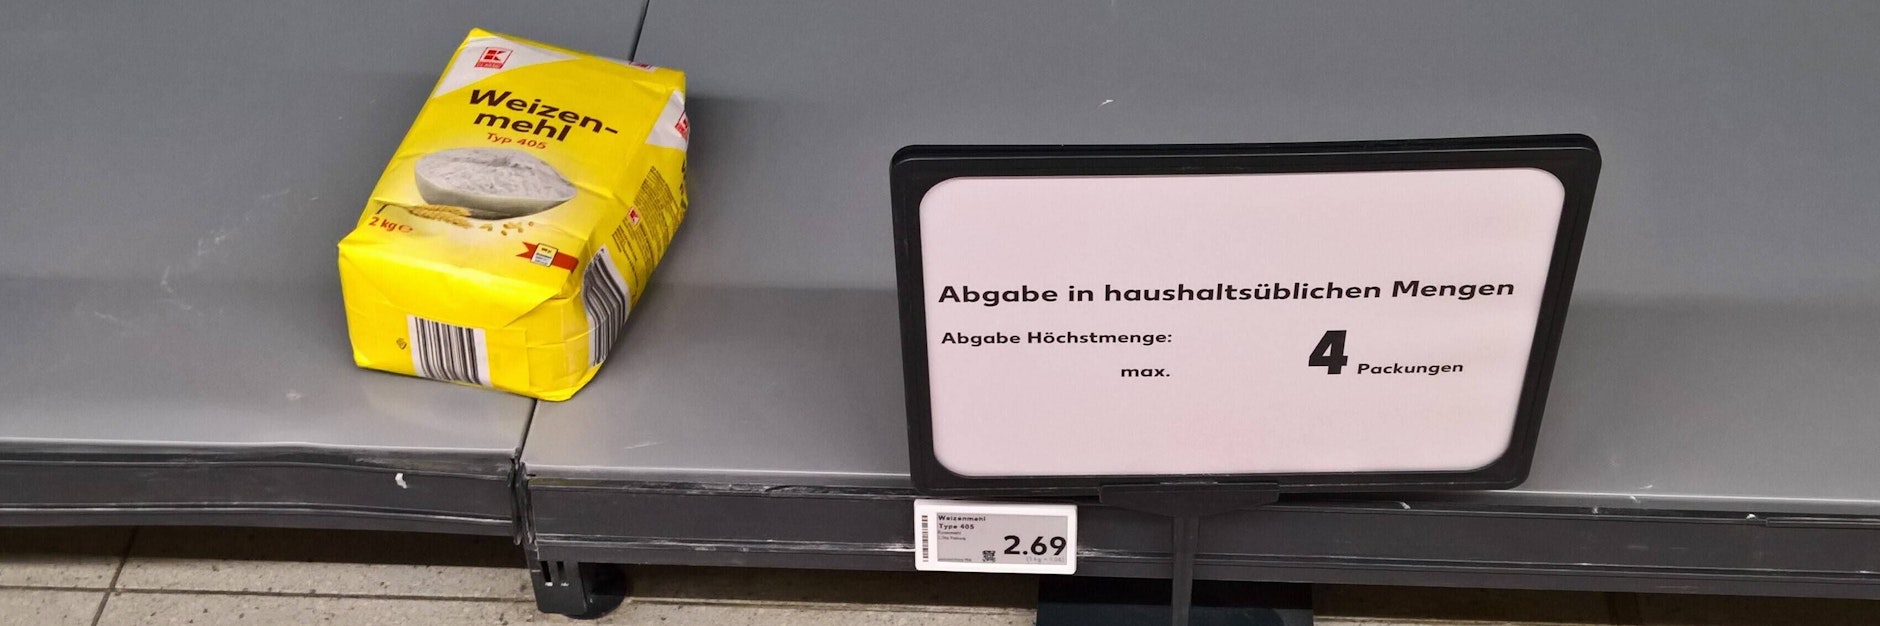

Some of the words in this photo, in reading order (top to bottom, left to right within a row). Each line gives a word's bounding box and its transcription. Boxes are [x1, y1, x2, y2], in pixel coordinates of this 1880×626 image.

[470, 89, 619, 135] Weizen-
[473, 112, 572, 142] mehl
[486, 132, 512, 145] Typ
[516, 137, 548, 150] 405
[368, 215, 380, 227] 2
[380, 218, 398, 232] kg
[938, 284, 1058, 307] Abgabe
[1068, 282, 1094, 302] in
[1104, 280, 1381, 302] haushaltsüblichen
[1392, 279, 1514, 302] Mengen
[941, 331, 1021, 347] Abgabe
[1027, 329, 1172, 346] Höchstmenge:
[1308, 329, 1349, 375] 4
[1357, 360, 1464, 377] Packungen
[1120, 367, 1171, 379] max.
[1003, 535, 1067, 556] 2.69
